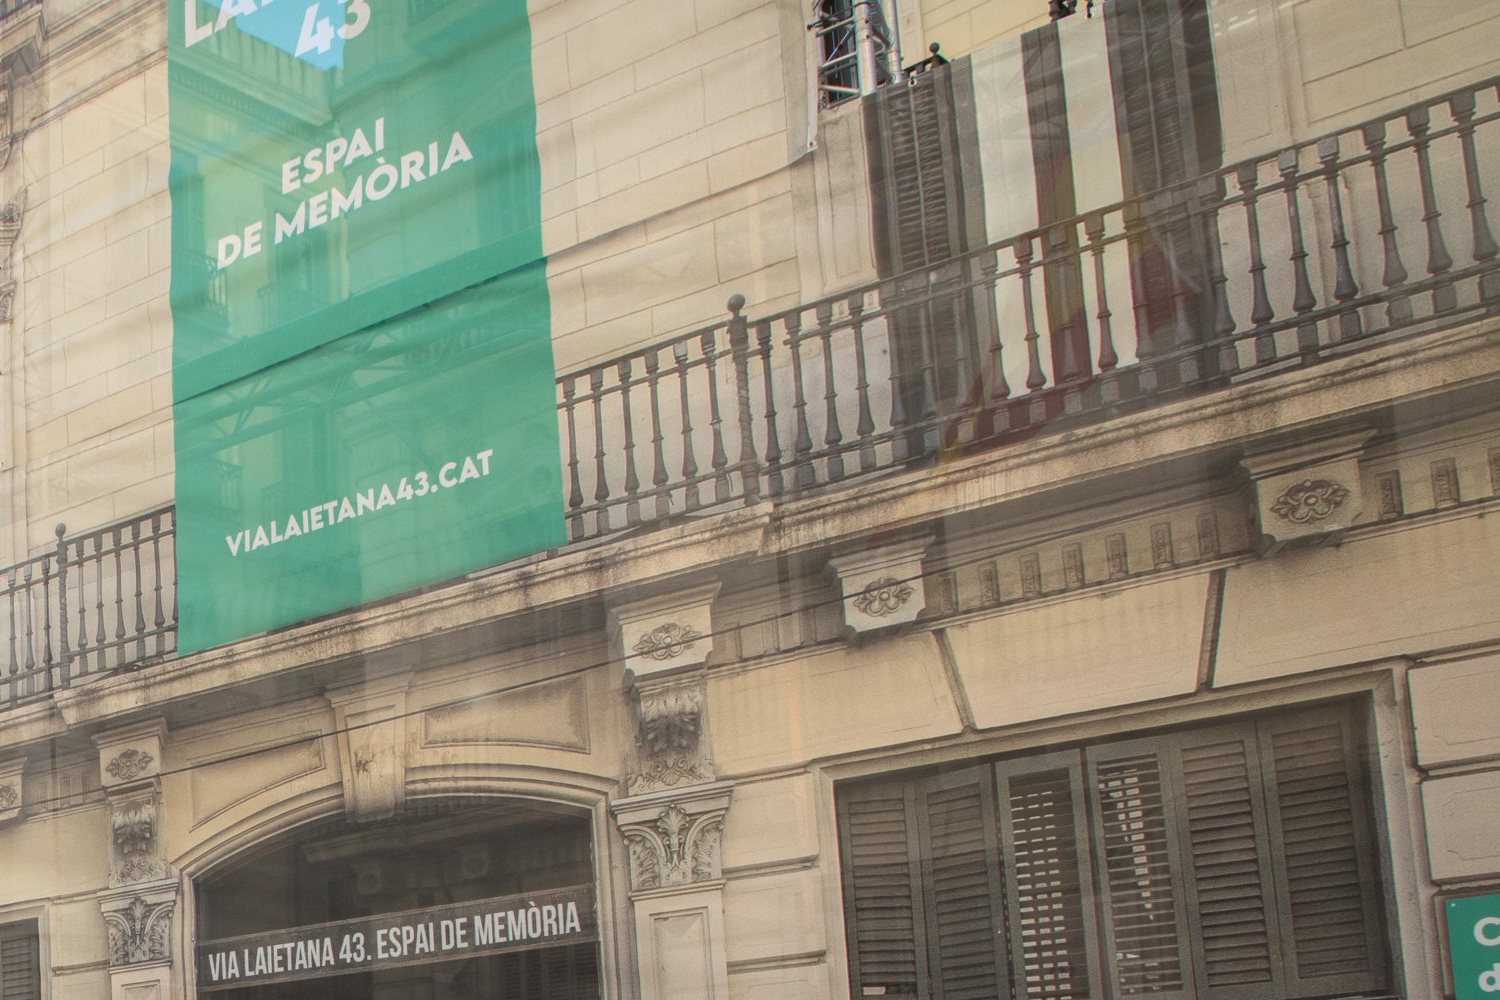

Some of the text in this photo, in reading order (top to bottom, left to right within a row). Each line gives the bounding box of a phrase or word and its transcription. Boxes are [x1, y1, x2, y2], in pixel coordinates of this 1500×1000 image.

[294, 0, 371, 58] 43
[282, 118, 384, 195] ESPAI
[218, 132, 473, 270] DE MEMÒRIA
[225, 449, 493, 557] VIALAIETANA43.CAT
[209, 902, 581, 981] VIA LAIETANA 43. ESPAI DE MEMÒRIA
